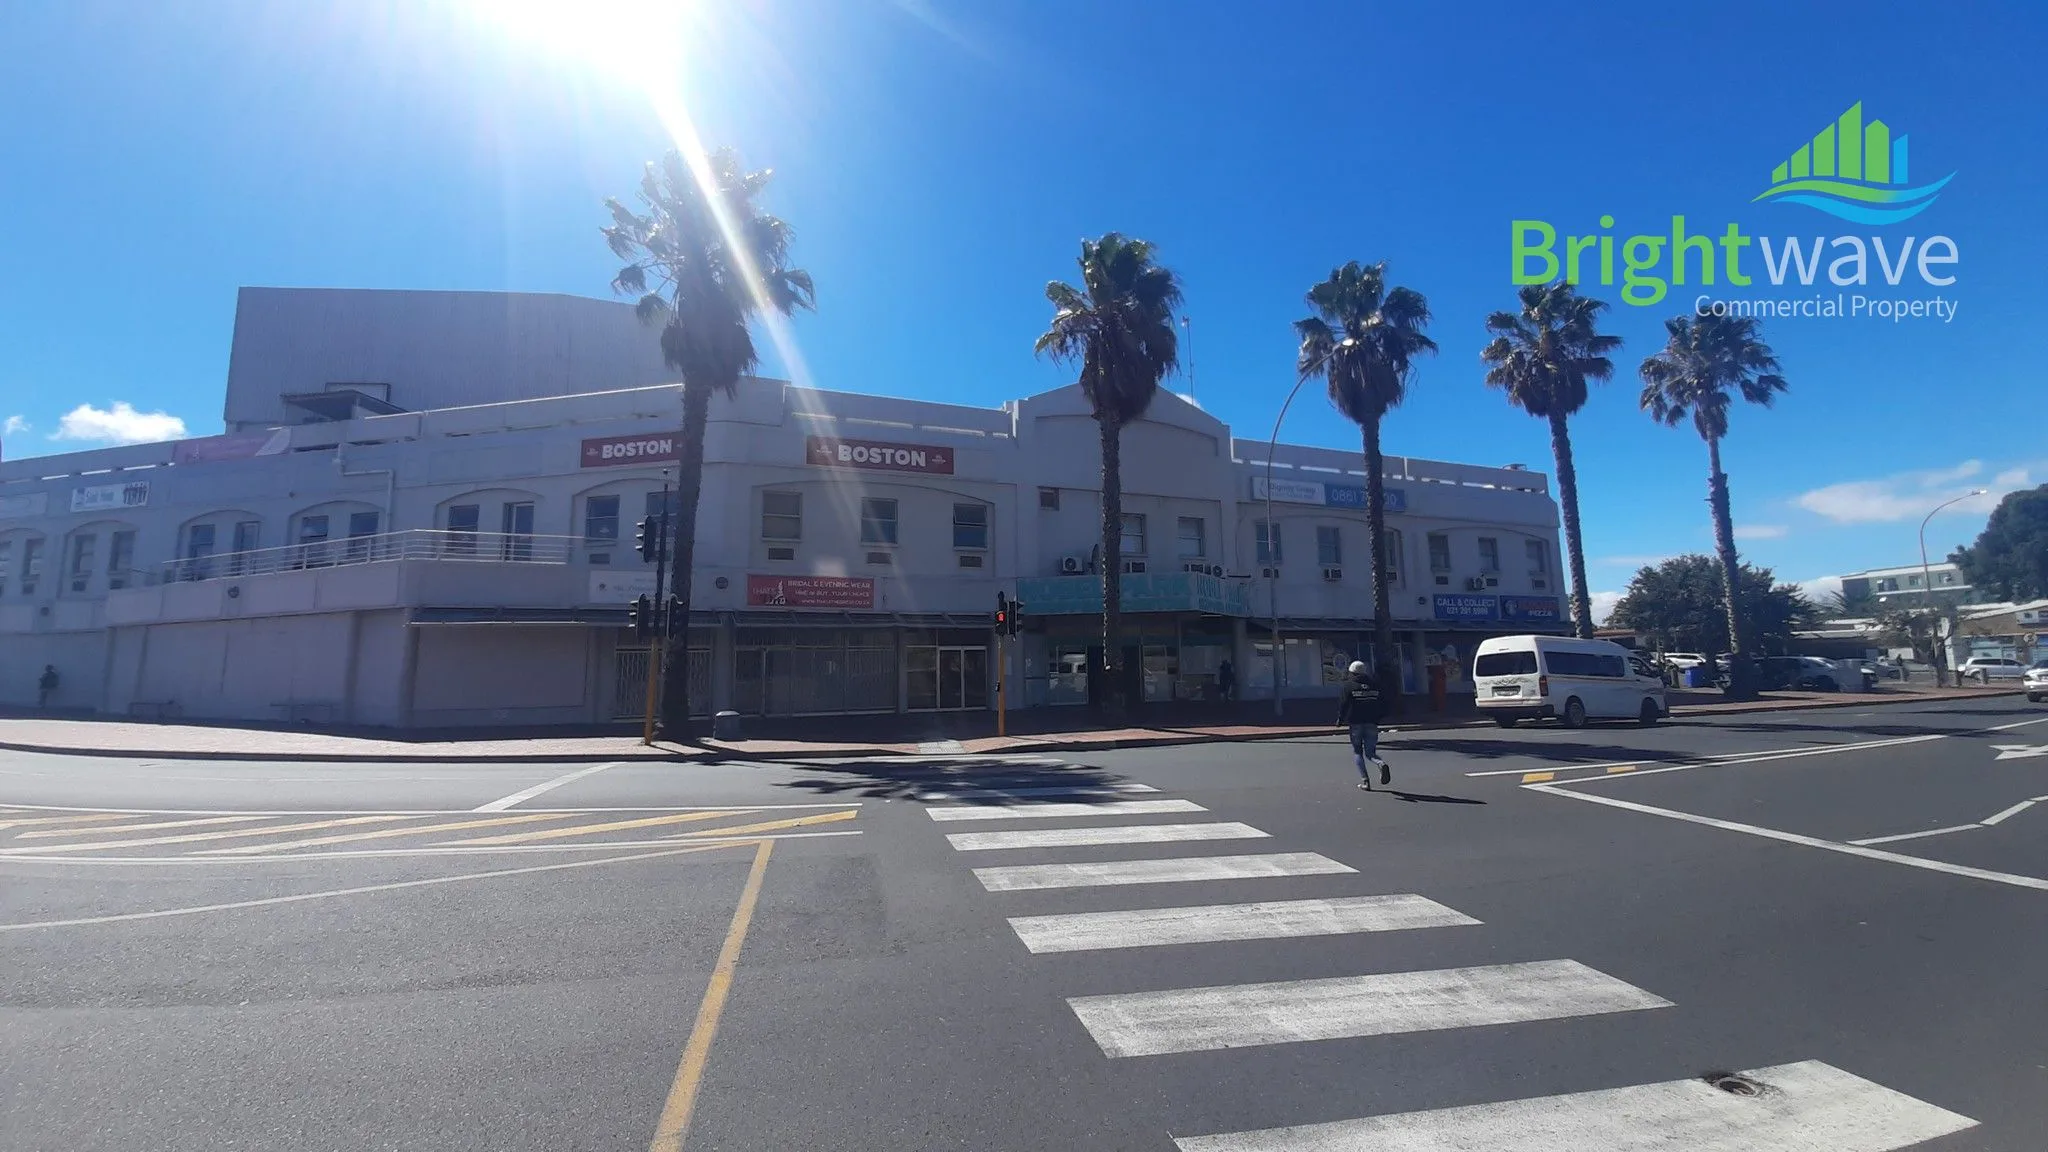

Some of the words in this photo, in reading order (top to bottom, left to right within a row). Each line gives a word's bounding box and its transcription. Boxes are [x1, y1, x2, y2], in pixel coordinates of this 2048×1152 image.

[601, 439, 673, 459] BOSTON
[838, 444, 926, 467] BOSTON
[787, 580, 813, 588] BRIDAL
[819, 580, 849, 589] EVENING
[850, 581, 871, 589] WEAR
[1437, 598, 1457, 607] CALL
[1463, 598, 1495, 607] COLLECT
